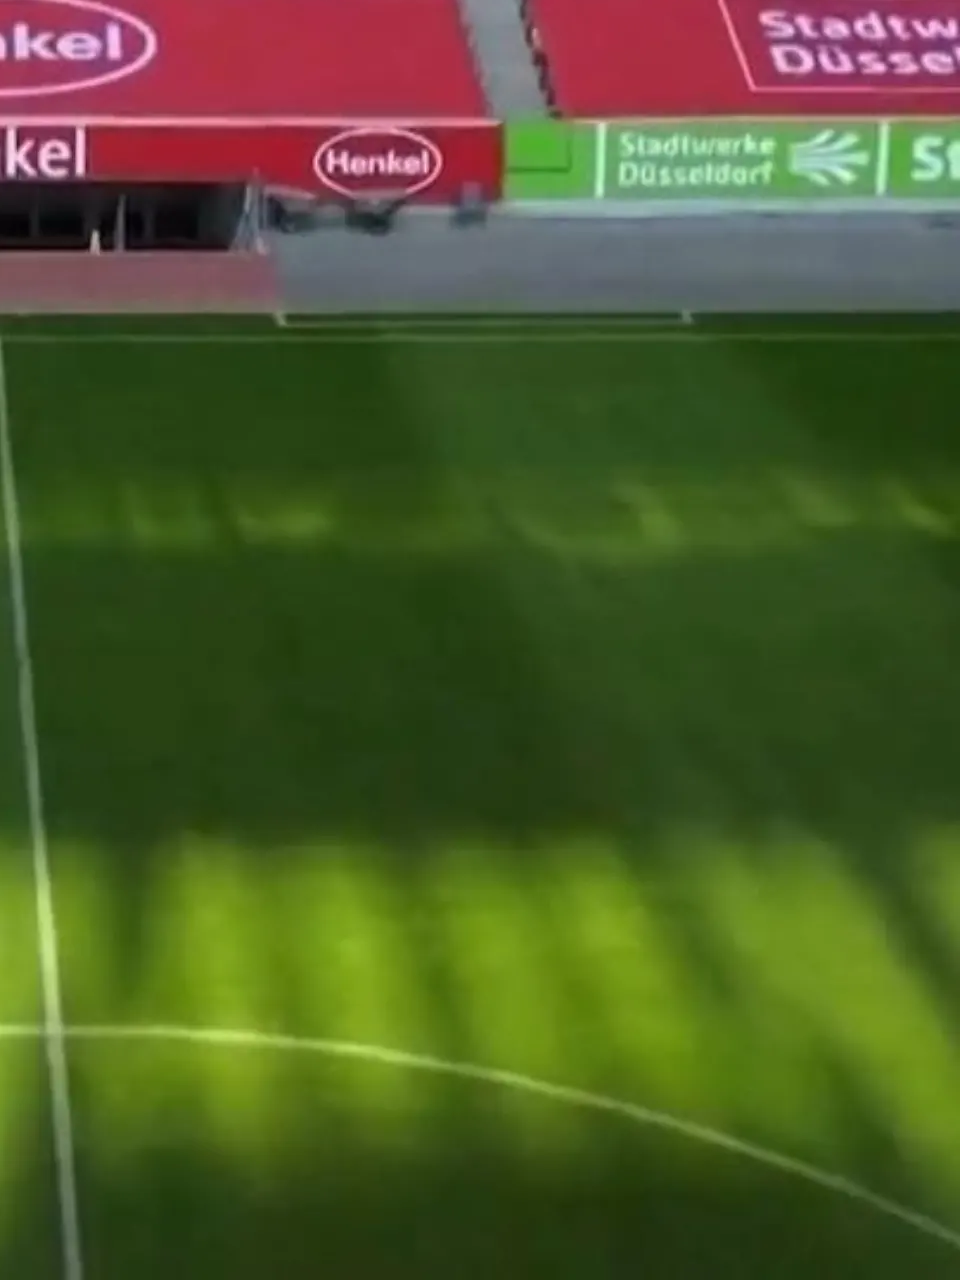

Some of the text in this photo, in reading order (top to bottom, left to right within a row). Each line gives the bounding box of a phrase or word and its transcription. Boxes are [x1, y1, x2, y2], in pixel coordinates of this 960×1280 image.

[619, 131, 777, 159] Stadtwerke
[325, 150, 430, 176] Henkel
[619, 160, 775, 188] Düsseldorf
